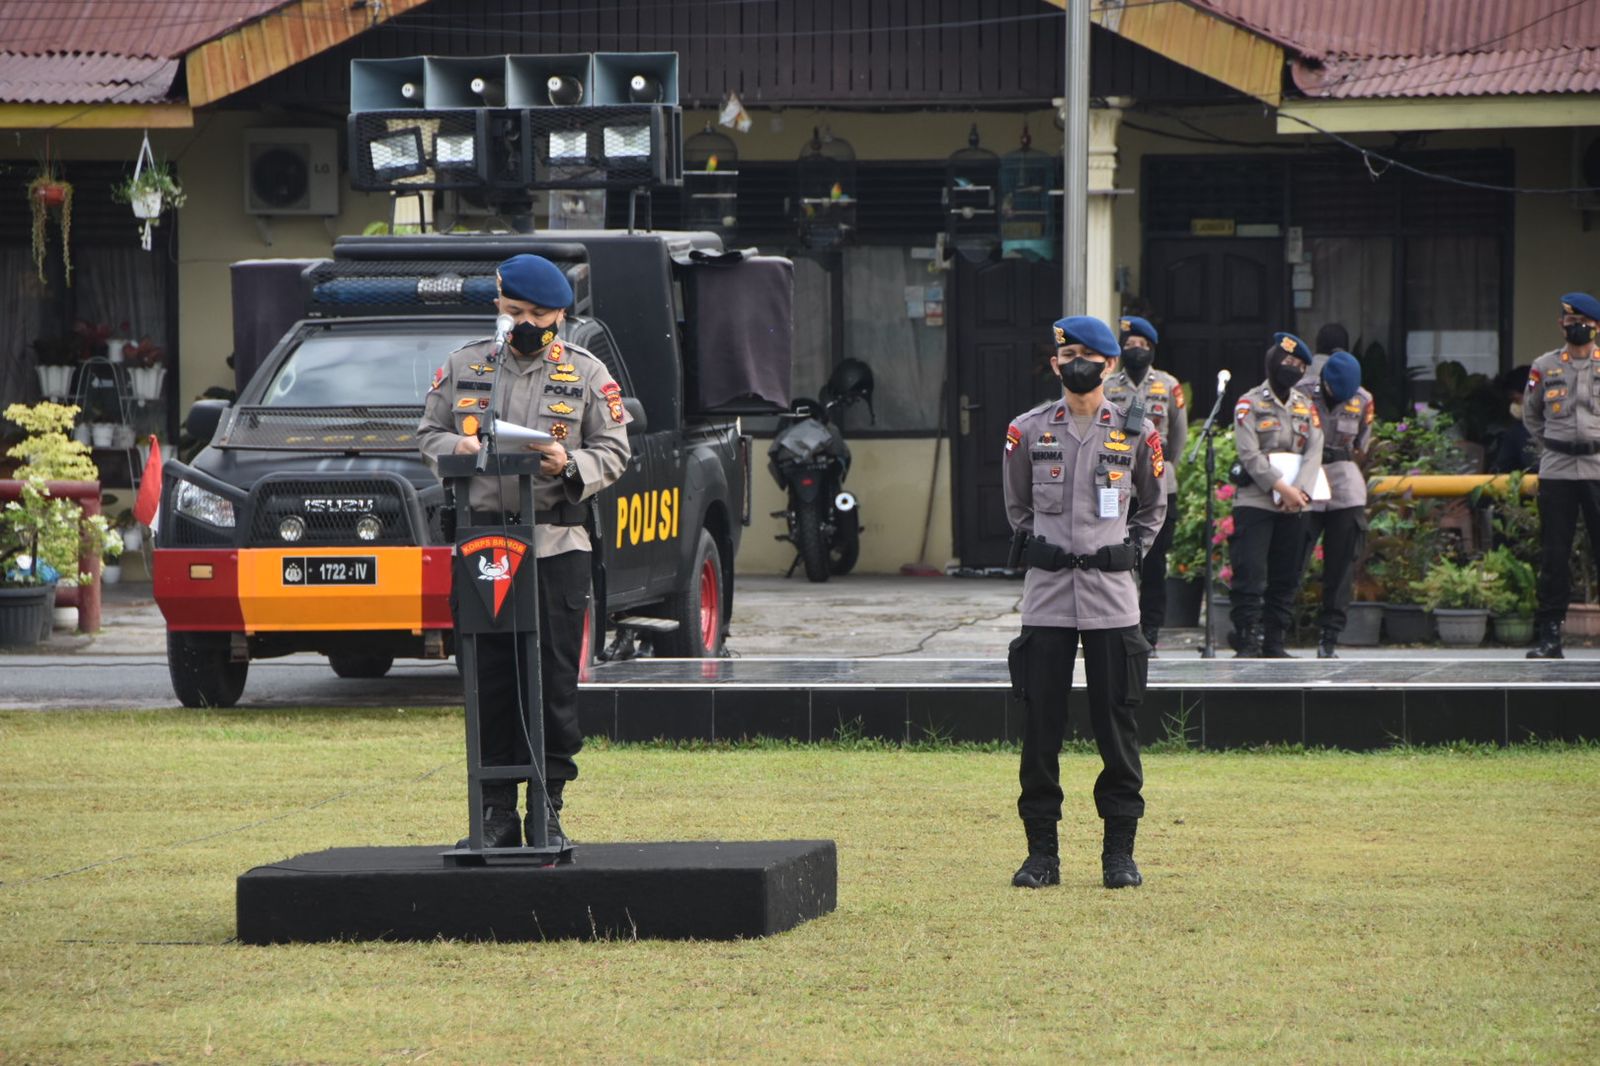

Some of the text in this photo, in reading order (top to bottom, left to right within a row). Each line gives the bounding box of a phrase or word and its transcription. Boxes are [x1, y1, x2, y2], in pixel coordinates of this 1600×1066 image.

[314, 163, 330, 174] LG
[544, 385, 583, 397] POLRI
[1099, 454, 1132, 466] POLRI
[304, 499, 373, 512] ISUZU
[463, 539, 491, 553] KORPS
[319, 563, 346, 580] 1722
